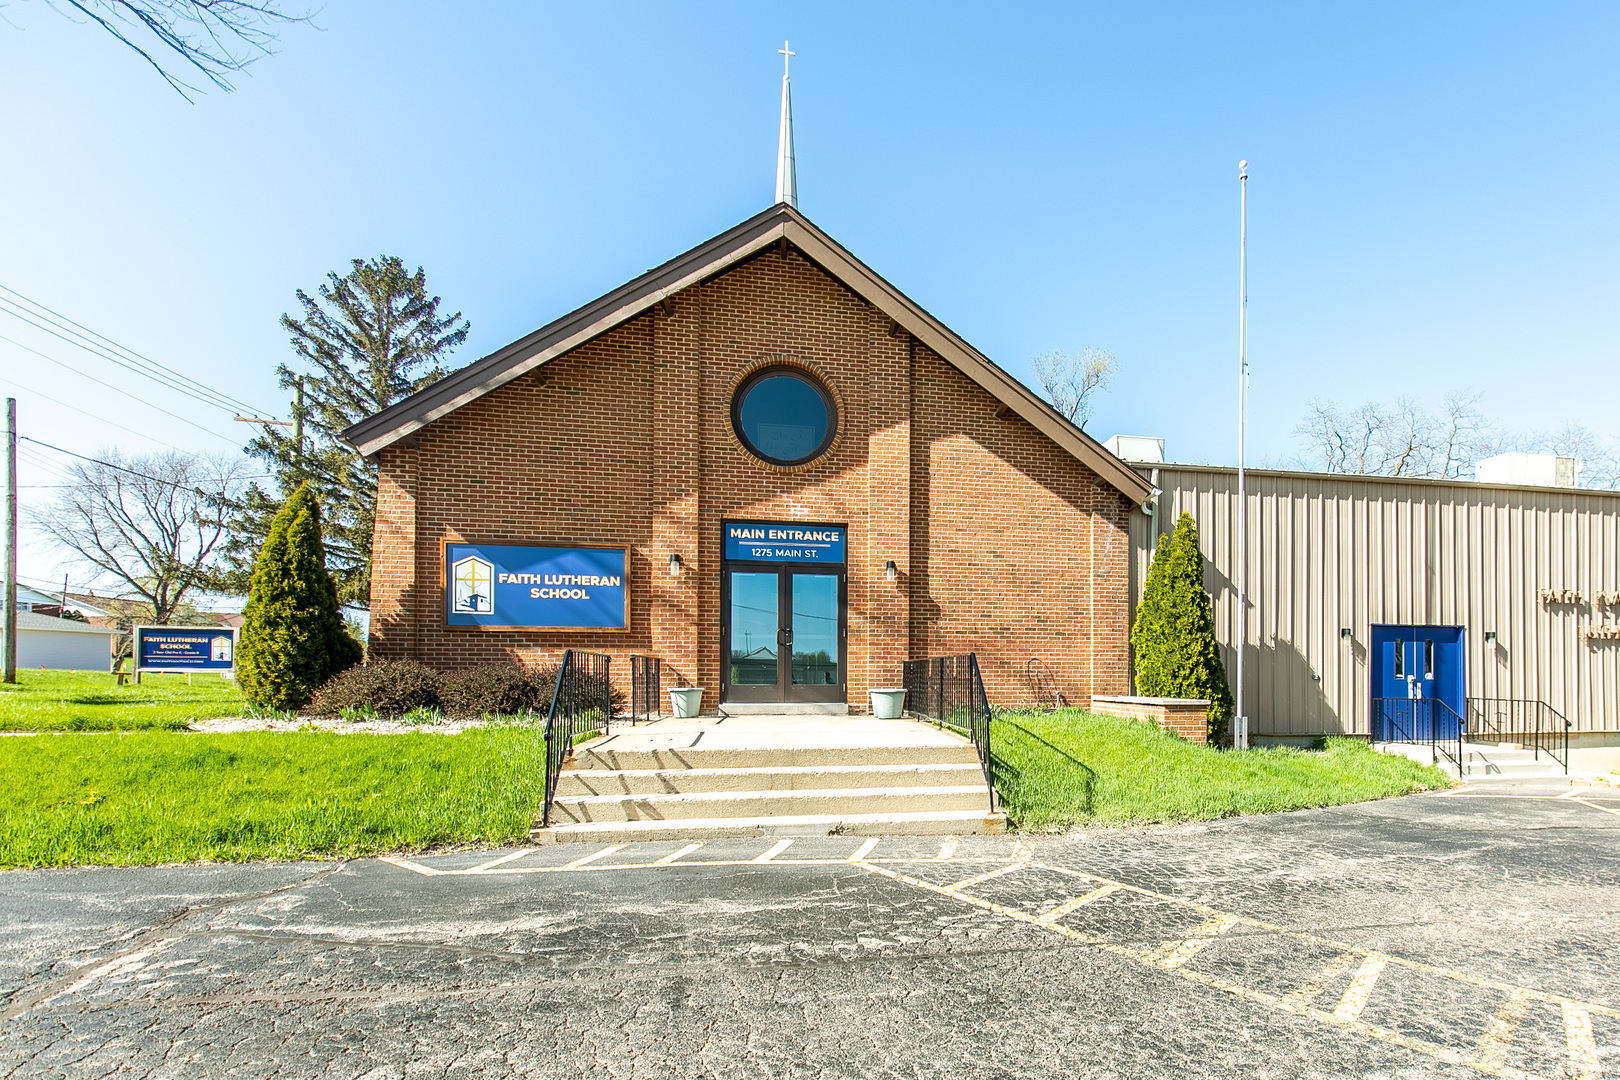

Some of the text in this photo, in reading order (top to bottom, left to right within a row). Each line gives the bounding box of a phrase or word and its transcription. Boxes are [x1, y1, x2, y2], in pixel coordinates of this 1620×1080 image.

[730, 528, 840, 542] MAIN ENTRANCE
[751, 548, 819, 559] 1275 MAIN ST.
[498, 572, 621, 587] FAITH LUTHERAN
[530, 587, 591, 600] SCHOOL
